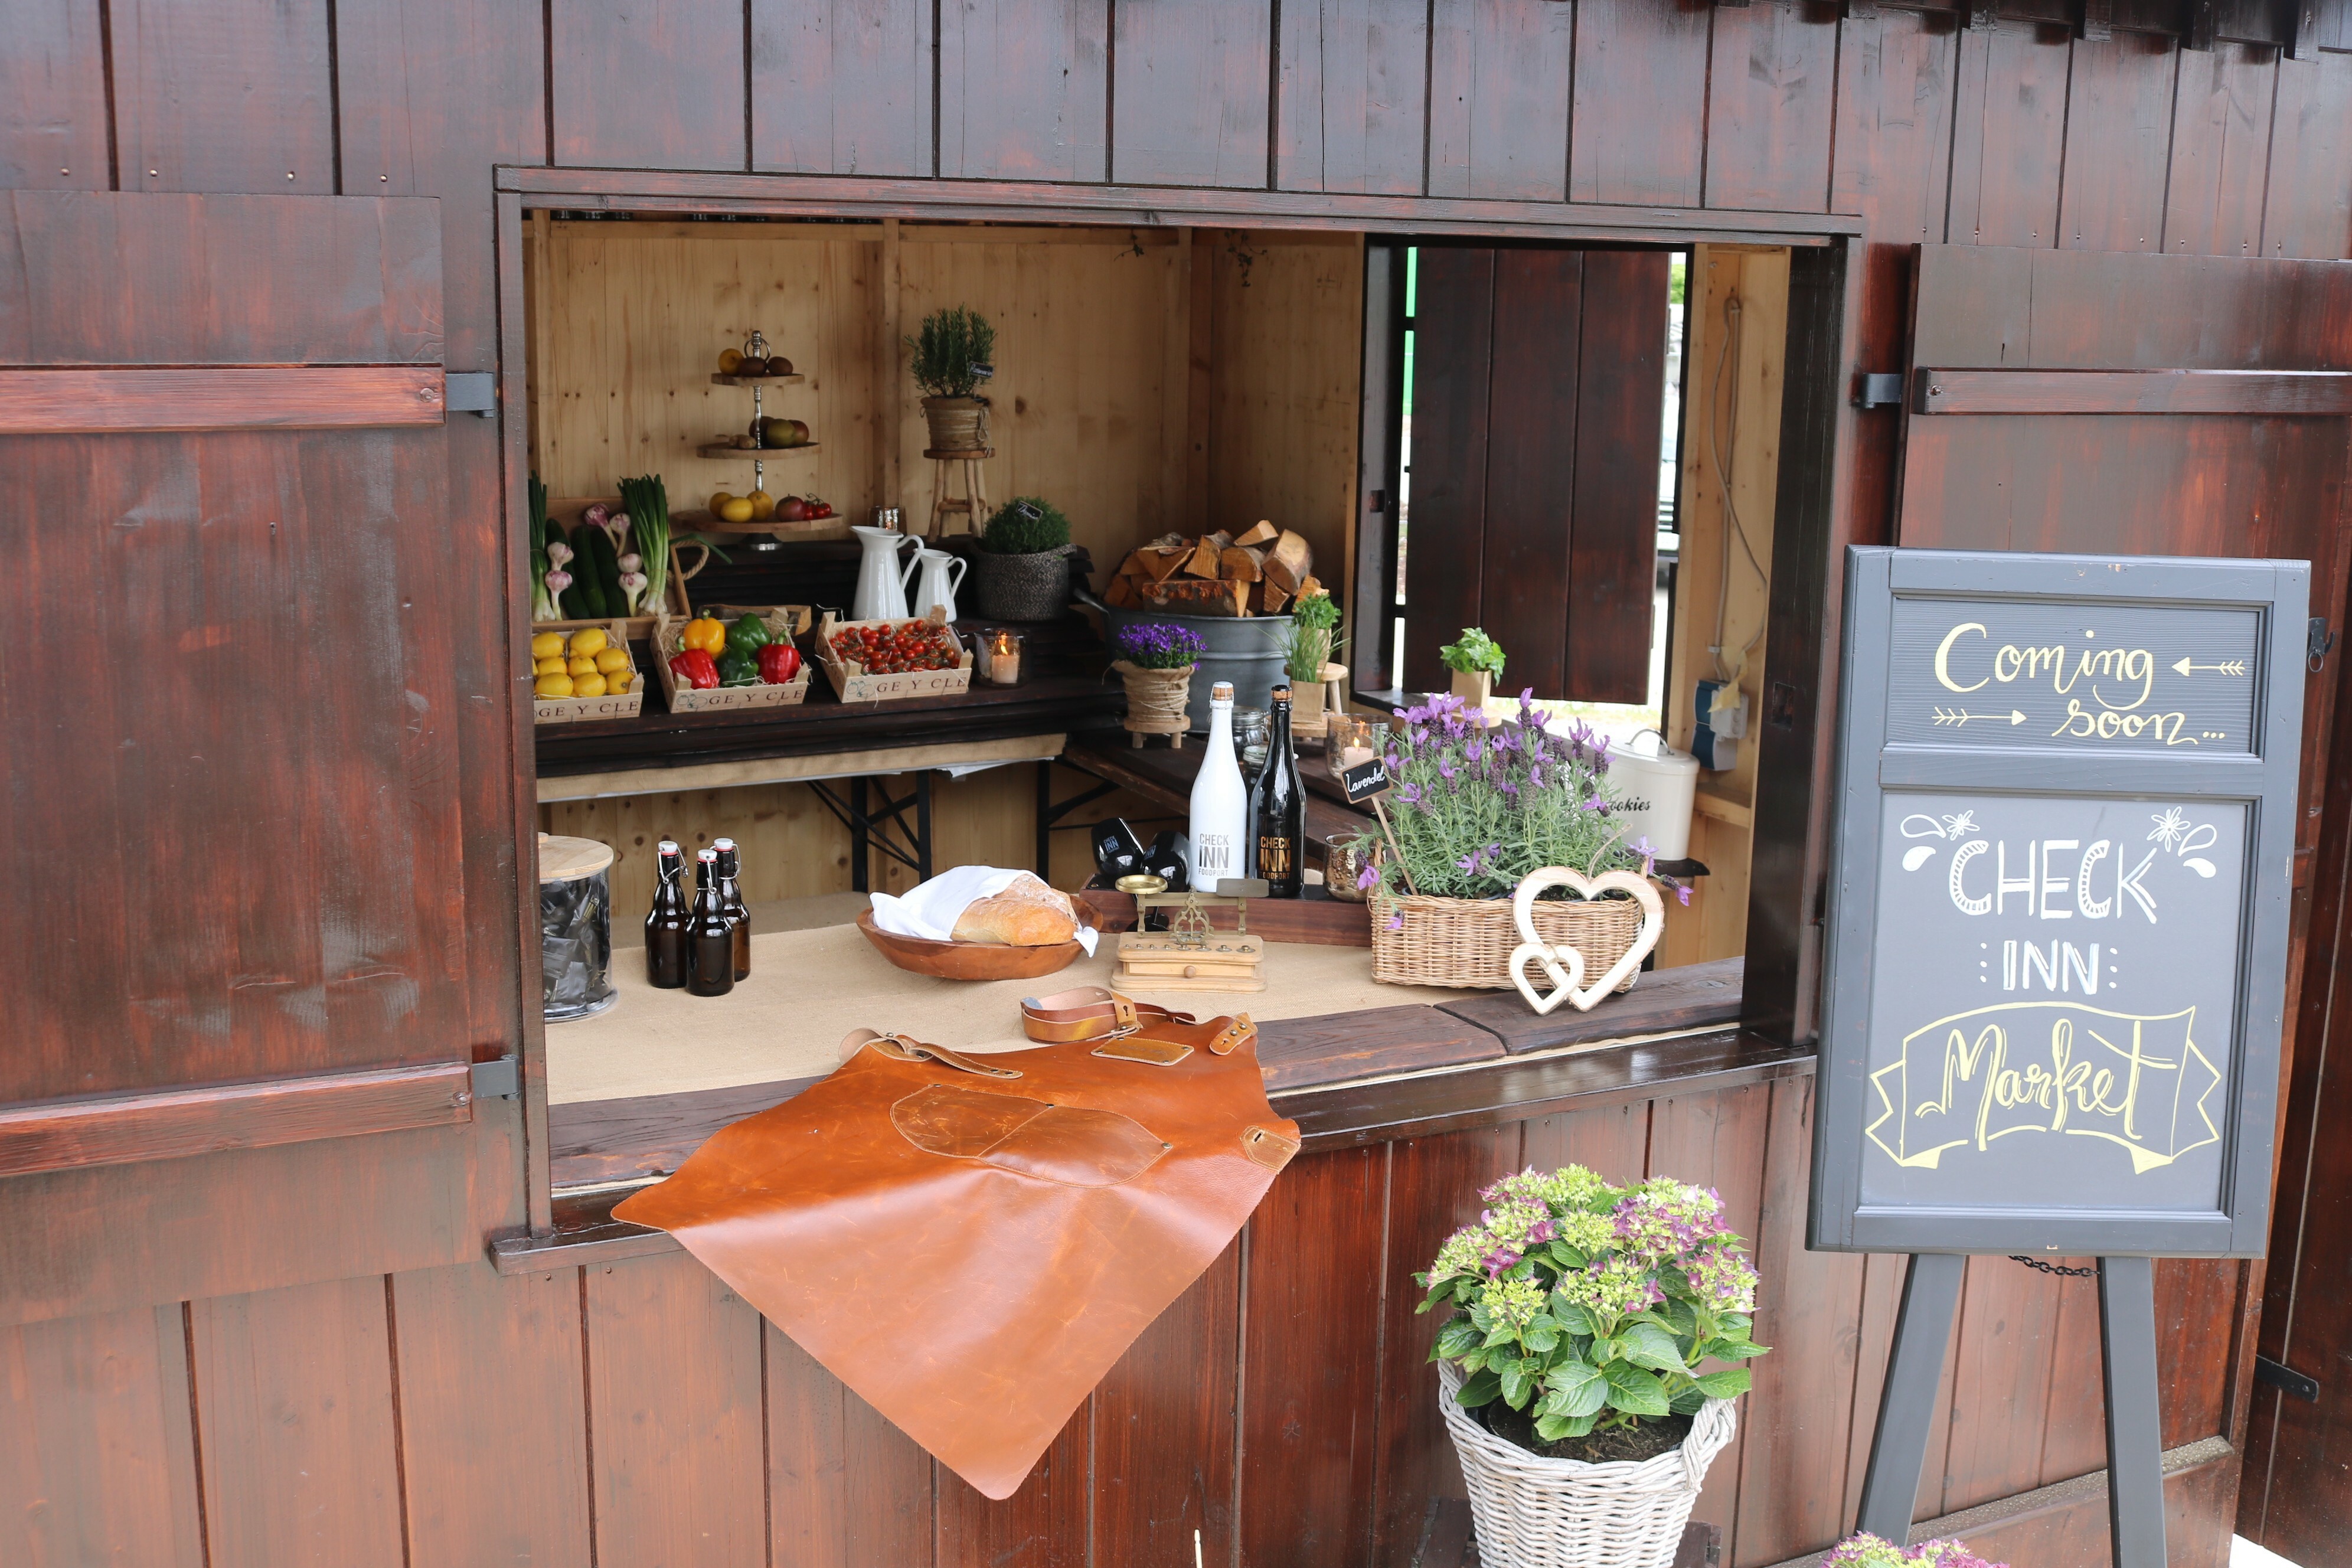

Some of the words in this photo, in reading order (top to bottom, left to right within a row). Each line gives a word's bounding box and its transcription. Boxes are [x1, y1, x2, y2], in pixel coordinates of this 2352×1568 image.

[1935, 623, 2153, 710] Coming
[1605, 796, 1651, 812] ookies
[1105, 838, 1119, 852] INN
[1200, 833, 1230, 846] CHECK
[1260, 836, 1291, 849] CHECK
[1199, 845, 1230, 869] INN
[1260, 848, 1291, 873] INN
[1198, 868, 1229, 877] FOODPORT
[1949, 839, 2158, 925] CHECK
[2003, 939, 2100, 995] INN
[1915, 1018, 2178, 1151] Market
